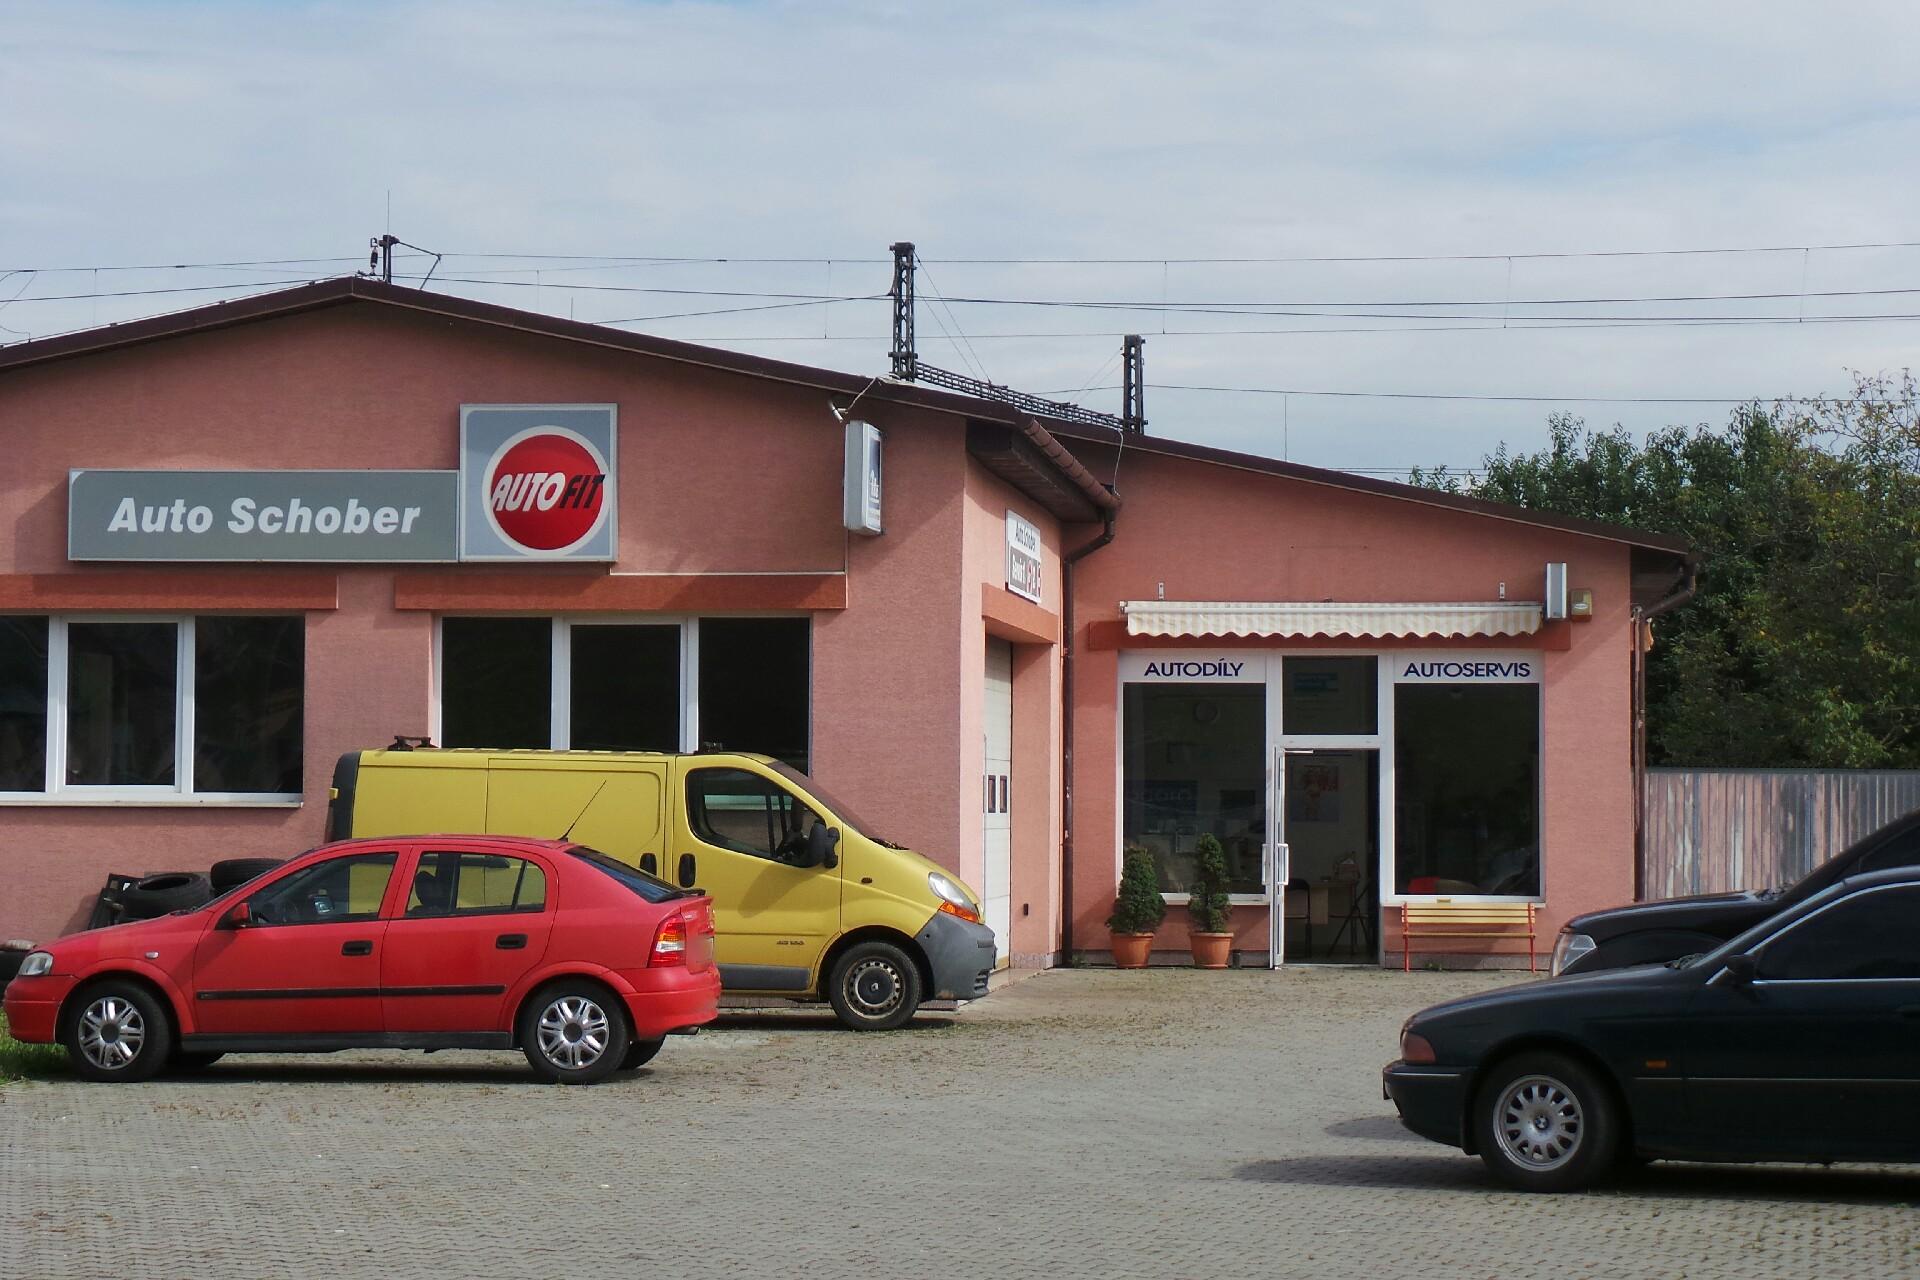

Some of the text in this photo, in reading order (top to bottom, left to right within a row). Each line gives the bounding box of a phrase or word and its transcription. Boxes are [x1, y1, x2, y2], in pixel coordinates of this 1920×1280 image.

[107, 497, 421, 534] Auto Schober
[1144, 657, 1244, 677] AUTODÍLY
[1403, 661, 1531, 678] AUTOSERVIS
